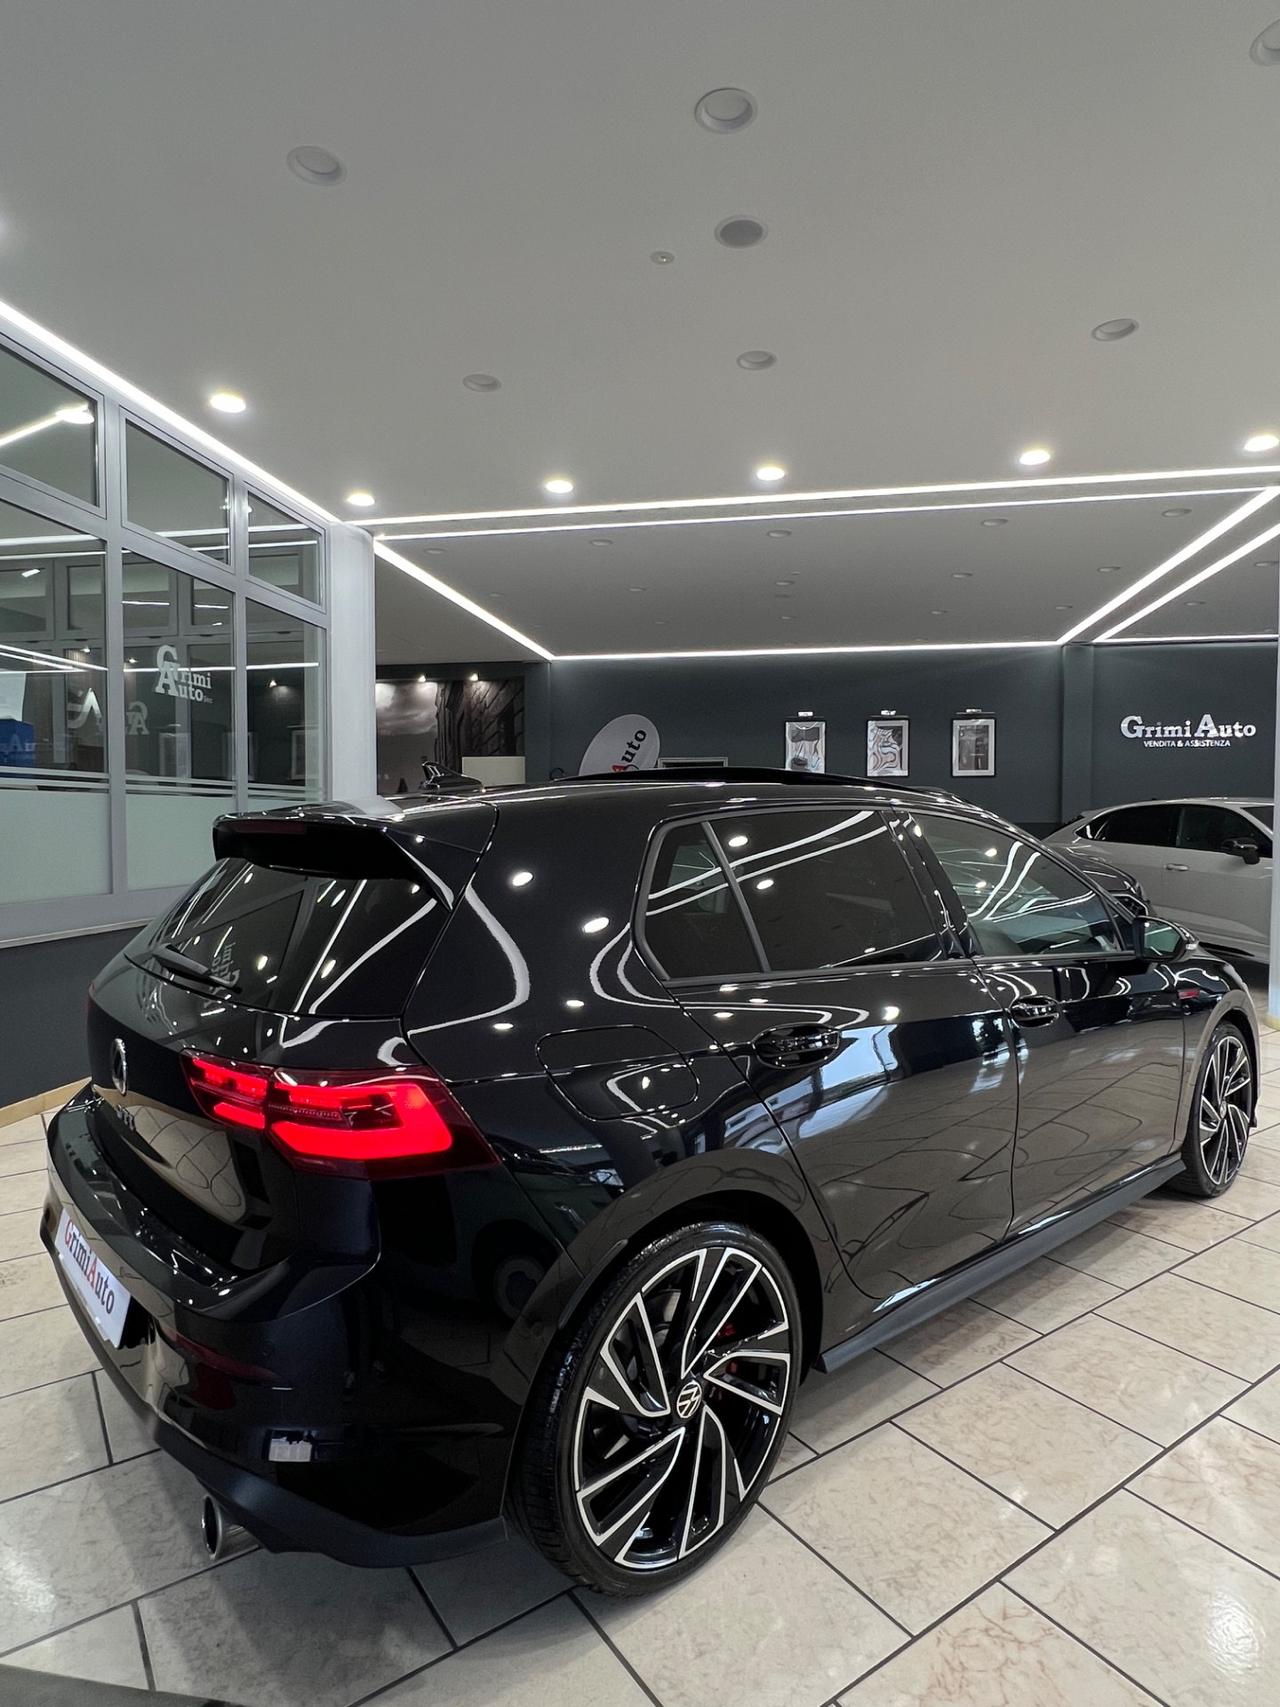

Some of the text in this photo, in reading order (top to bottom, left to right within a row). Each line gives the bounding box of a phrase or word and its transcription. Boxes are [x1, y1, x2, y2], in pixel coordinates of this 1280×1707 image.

[155, 661, 204, 702] Auto
[156, 644, 212, 689] Grimi
[1120, 713, 1257, 739] Grimi Auto
[1143, 739, 1231, 748] VENDITA & ASSISTENZA
